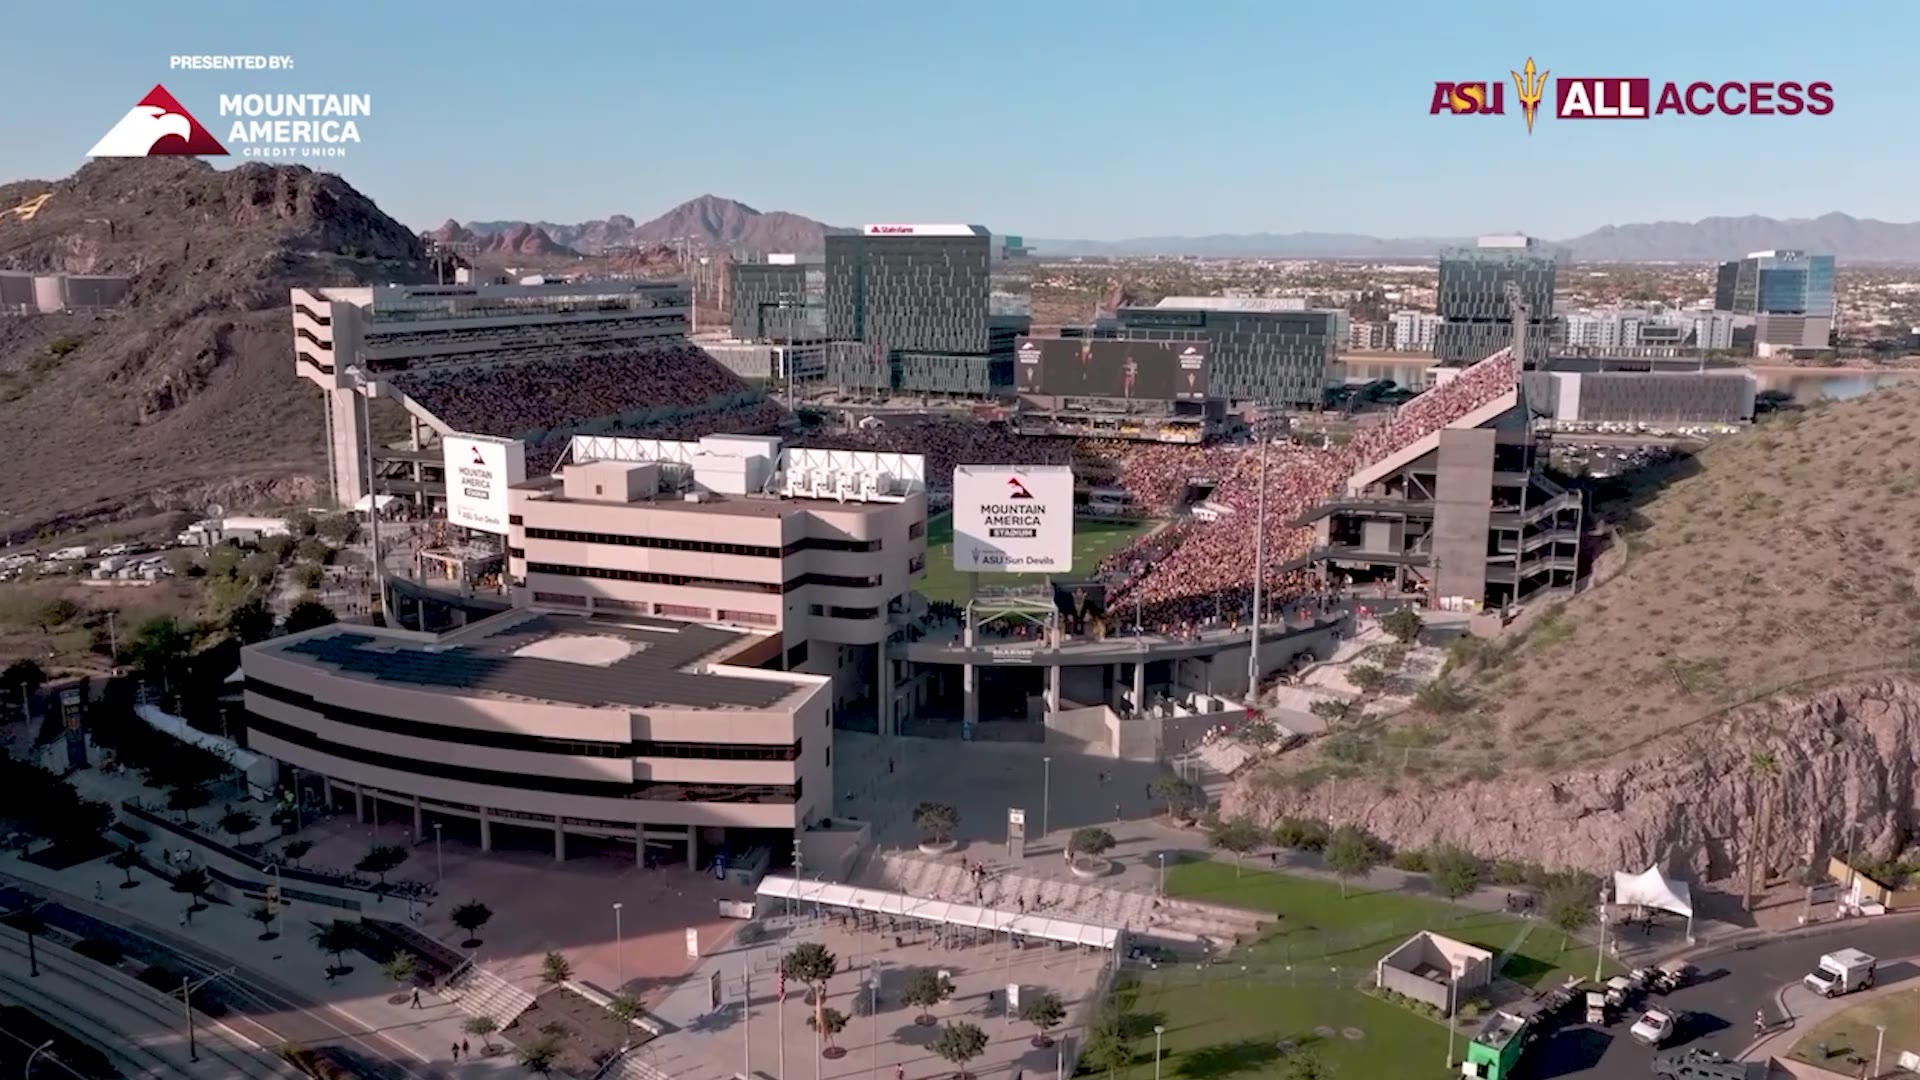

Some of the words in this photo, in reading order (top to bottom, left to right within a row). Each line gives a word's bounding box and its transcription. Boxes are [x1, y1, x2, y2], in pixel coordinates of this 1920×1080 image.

[459, 467, 493, 480] MOUNTAIN
[462, 477, 491, 489] AMERICA
[980, 504, 1046, 515] MOUNTAIN
[985, 515, 1042, 526] AMERICA
[992, 528, 1034, 537] STADIUM
[982, 556, 1003, 565] ASU
[1004, 556, 1024, 565] Sun
[1026, 556, 1055, 565] Devils
